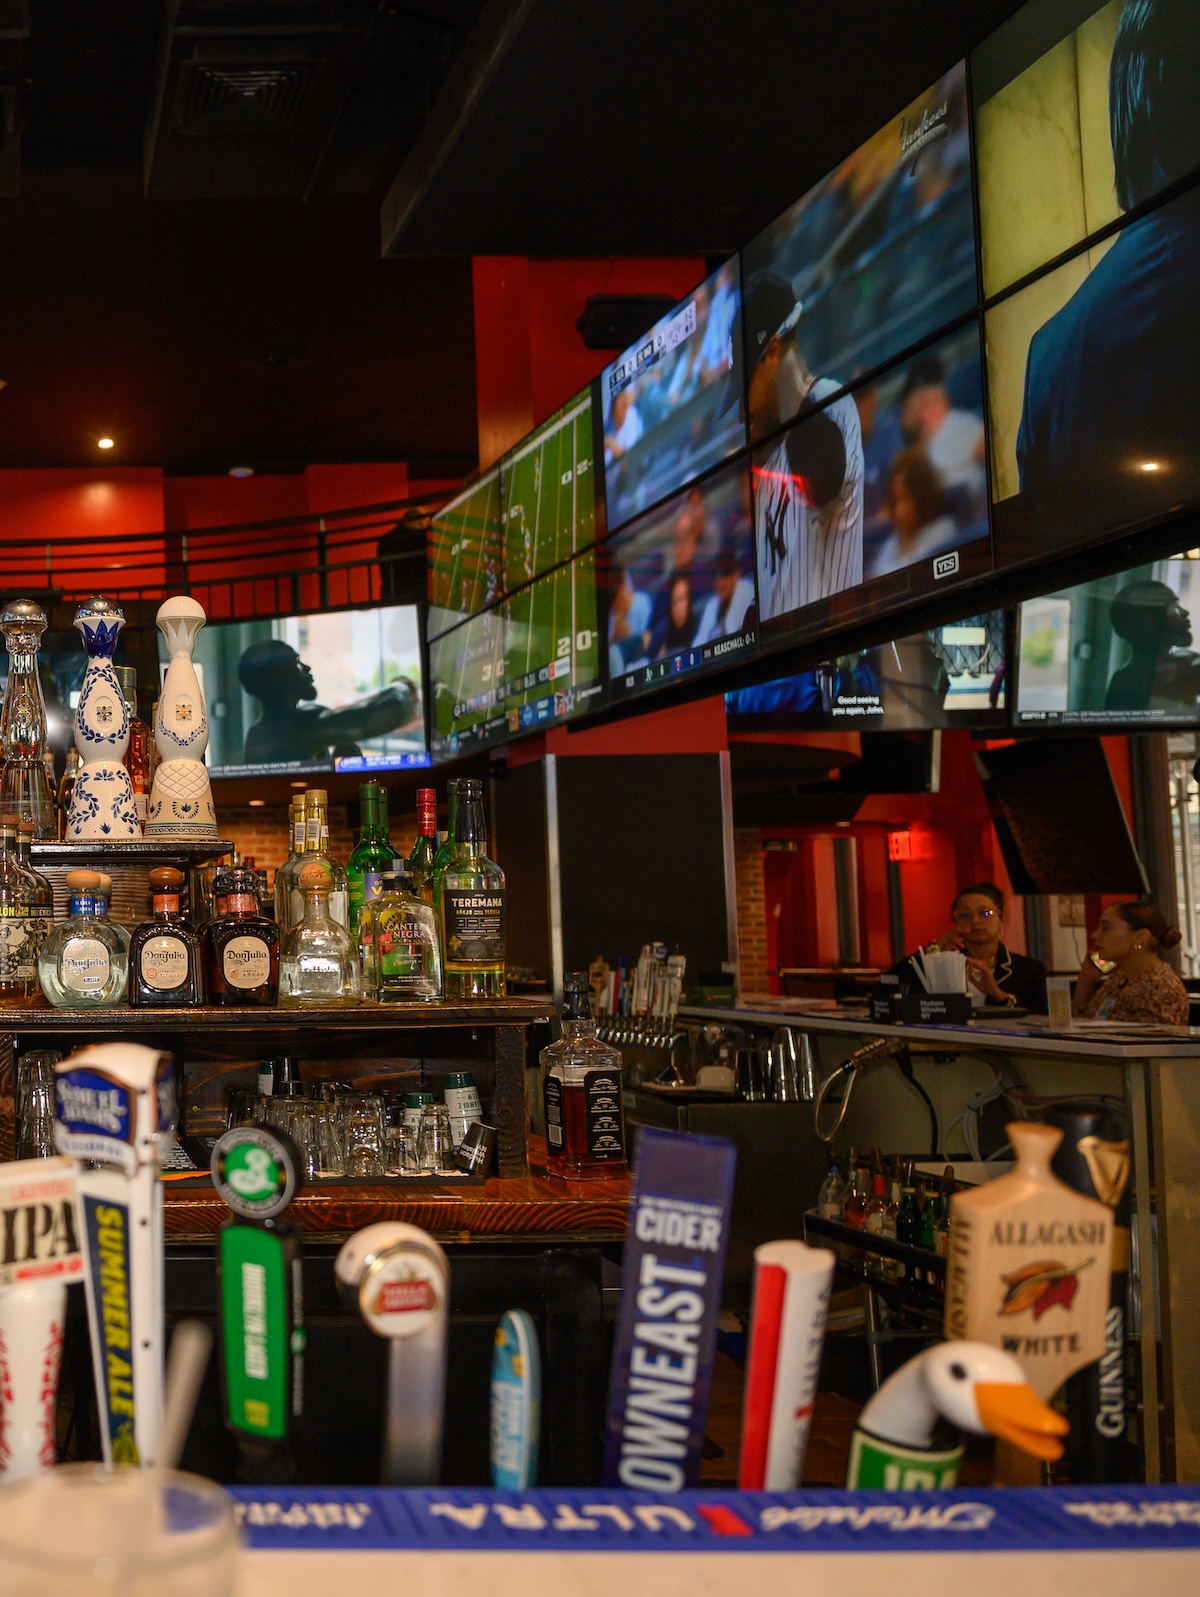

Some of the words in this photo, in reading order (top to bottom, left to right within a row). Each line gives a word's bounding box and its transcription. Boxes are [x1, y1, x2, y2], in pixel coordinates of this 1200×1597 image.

[937, 556, 955, 574] YES
[832, 707, 845, 717] you
[837, 695, 857, 705] Good
[857, 695, 880, 706] seeing
[451, 897, 503, 908] TEREMANA
[386, 922, 421, 931] CANTE
[393, 930, 426, 939] NEGRA
[1, 1200, 82, 1265] IPA
[635, 1206, 722, 1253] CIDER
[992, 1219, 1106, 1246] ALLAGASH
[95, 1205, 130, 1351] SUMMER
[1001, 1332, 1080, 1354] WHITE
[617, 1253, 708, 1493] OWNEAST
[1095, 1305, 1124, 1438] GUINNESS
[107, 1355, 134, 1417] ALE
[429, 1503, 695, 1533] ULTRA
